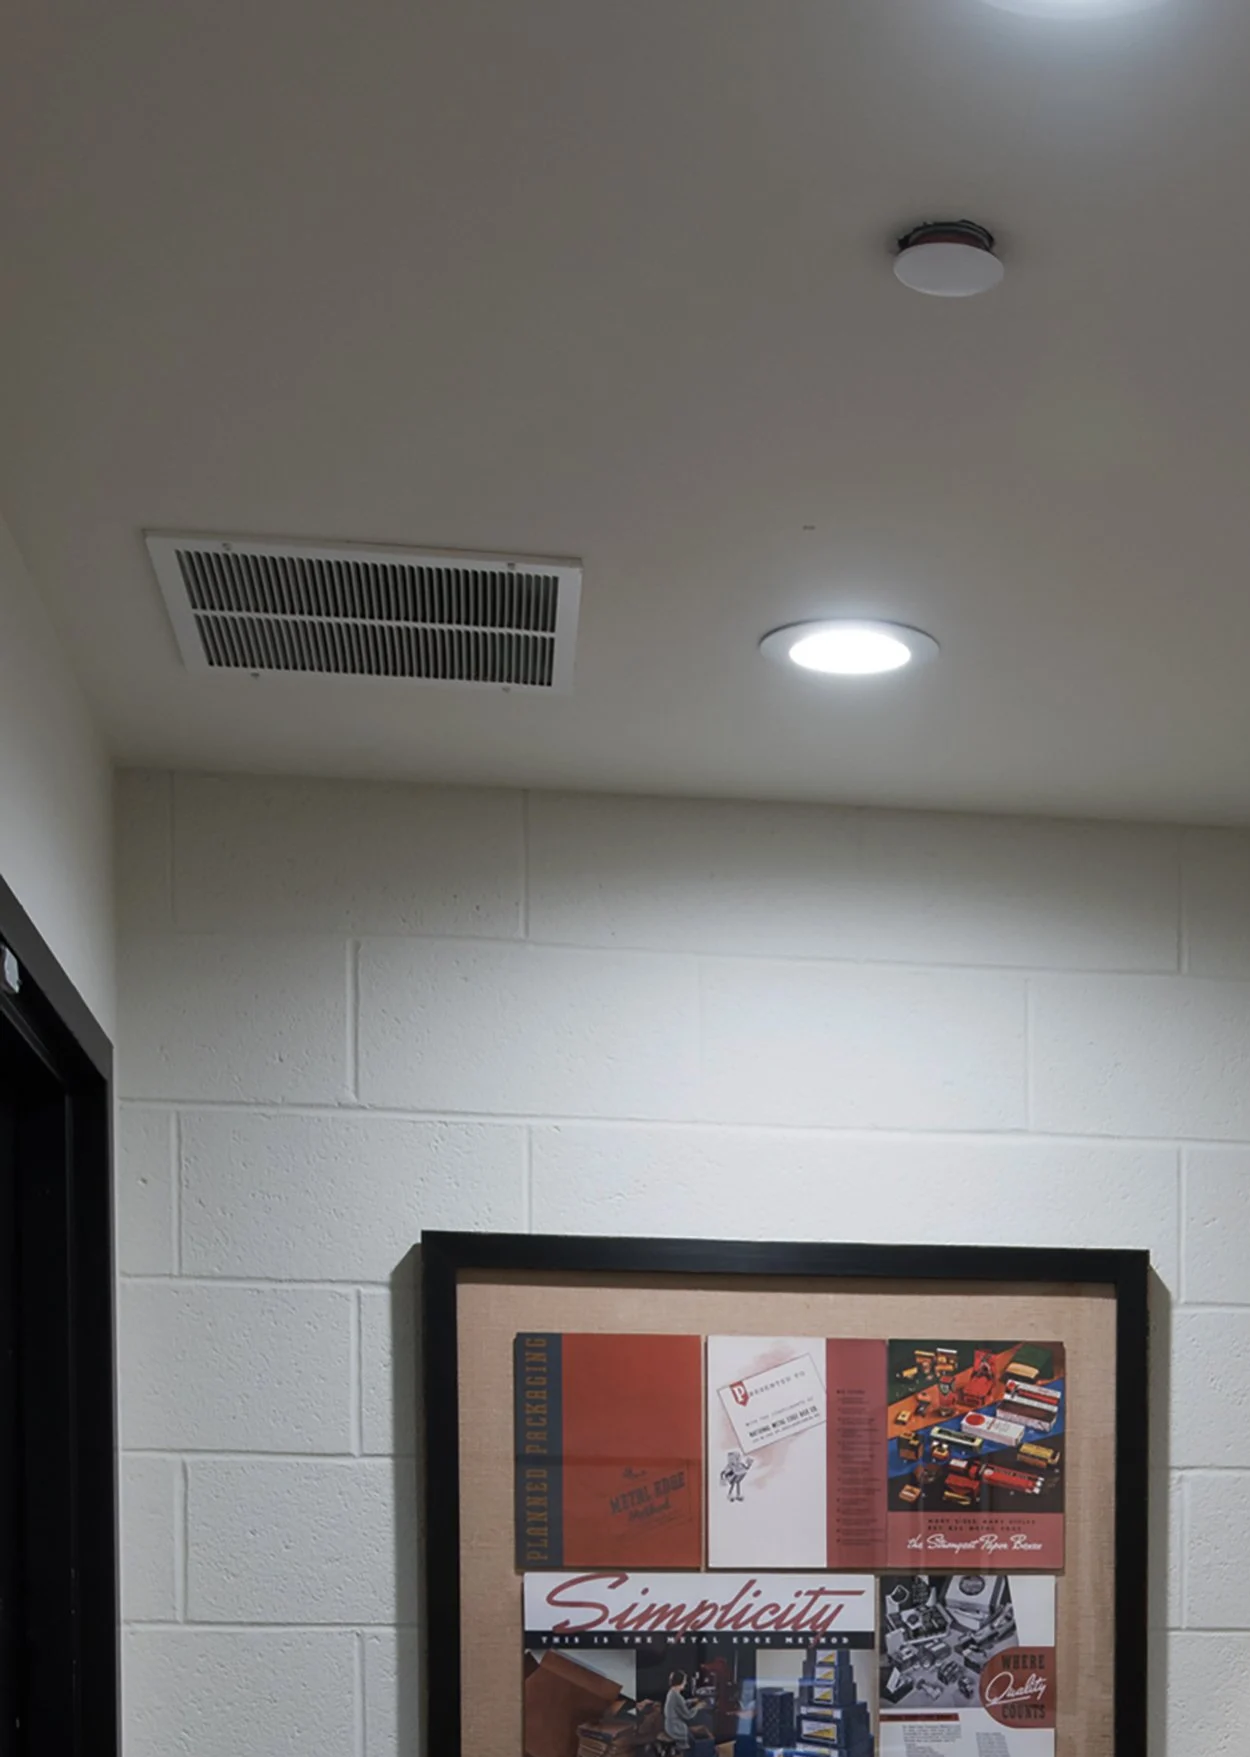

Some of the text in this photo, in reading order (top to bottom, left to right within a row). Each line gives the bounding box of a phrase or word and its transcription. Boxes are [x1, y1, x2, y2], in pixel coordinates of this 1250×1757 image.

[525, 1337, 548, 1560] PLANNED PACKAGING
[546, 1572, 865, 1645] Simplicity
[541, 1636, 849, 1644] THIS IS THE METAL EDGE METHOD
[1001, 1654, 1045, 1670] WHERE
[985, 1671, 1047, 1706] Quality
[1002, 1703, 1046, 1719] COUNTS
